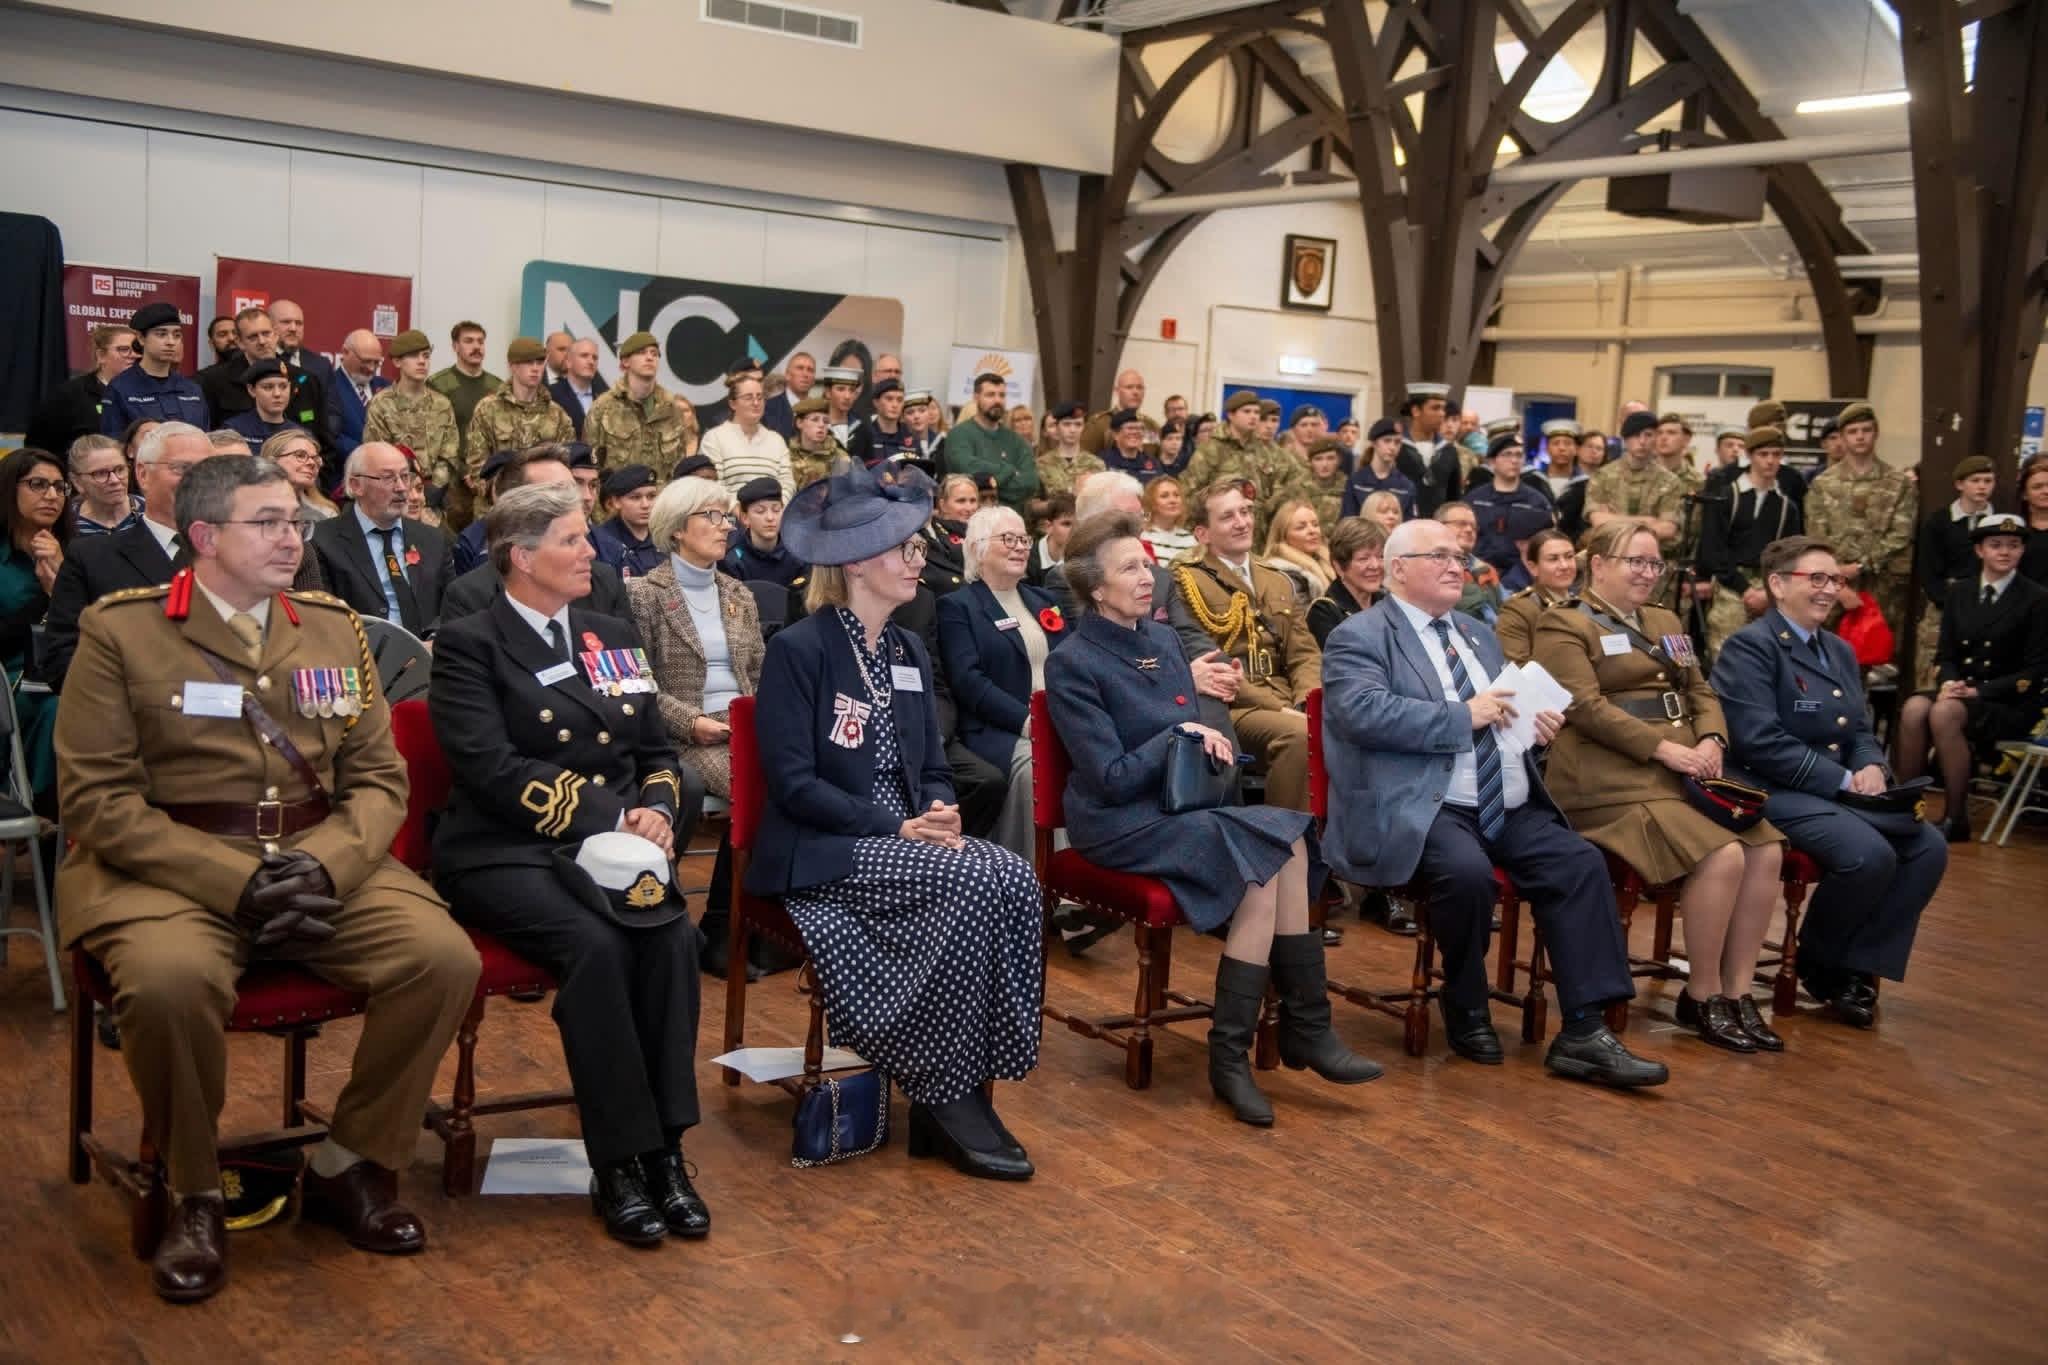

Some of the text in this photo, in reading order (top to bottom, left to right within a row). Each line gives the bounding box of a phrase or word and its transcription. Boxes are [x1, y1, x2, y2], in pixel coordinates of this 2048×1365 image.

[95, 279, 111, 291] RS
[115, 289, 143, 298] SUPPLY
[69, 304, 107, 318] GLOBAL
